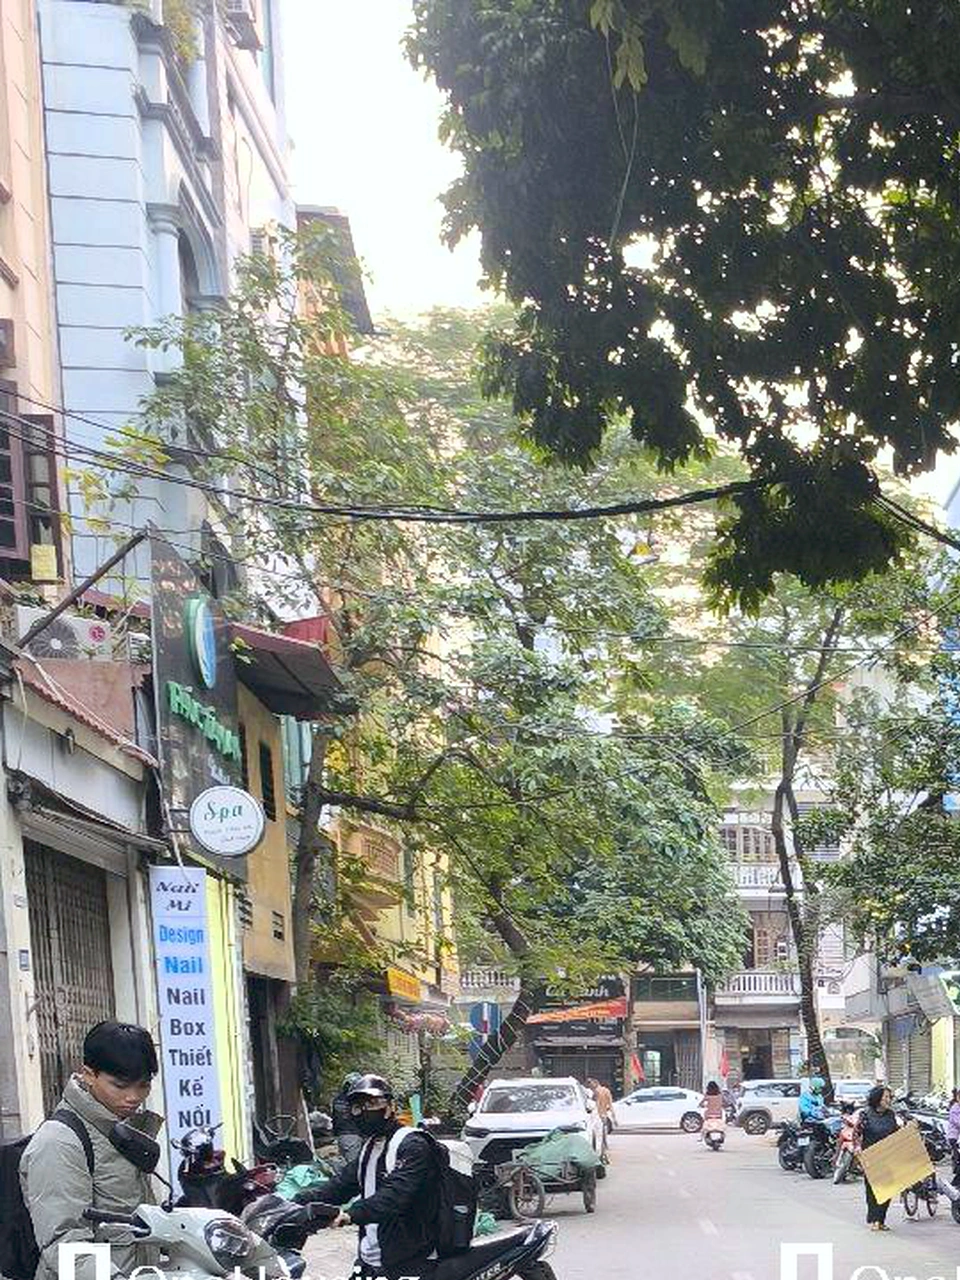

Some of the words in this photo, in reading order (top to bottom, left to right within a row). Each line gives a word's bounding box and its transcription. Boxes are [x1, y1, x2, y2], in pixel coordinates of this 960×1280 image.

[203, 801, 243, 823] Spa
[159, 924, 204, 945] Design
[164, 956, 203, 974] Nail
[166, 987, 205, 1005] Nail
[170, 1018, 206, 1036] Box
[168, 1045, 213, 1067] Thiết
[179, 1075, 204, 1097] Kế
